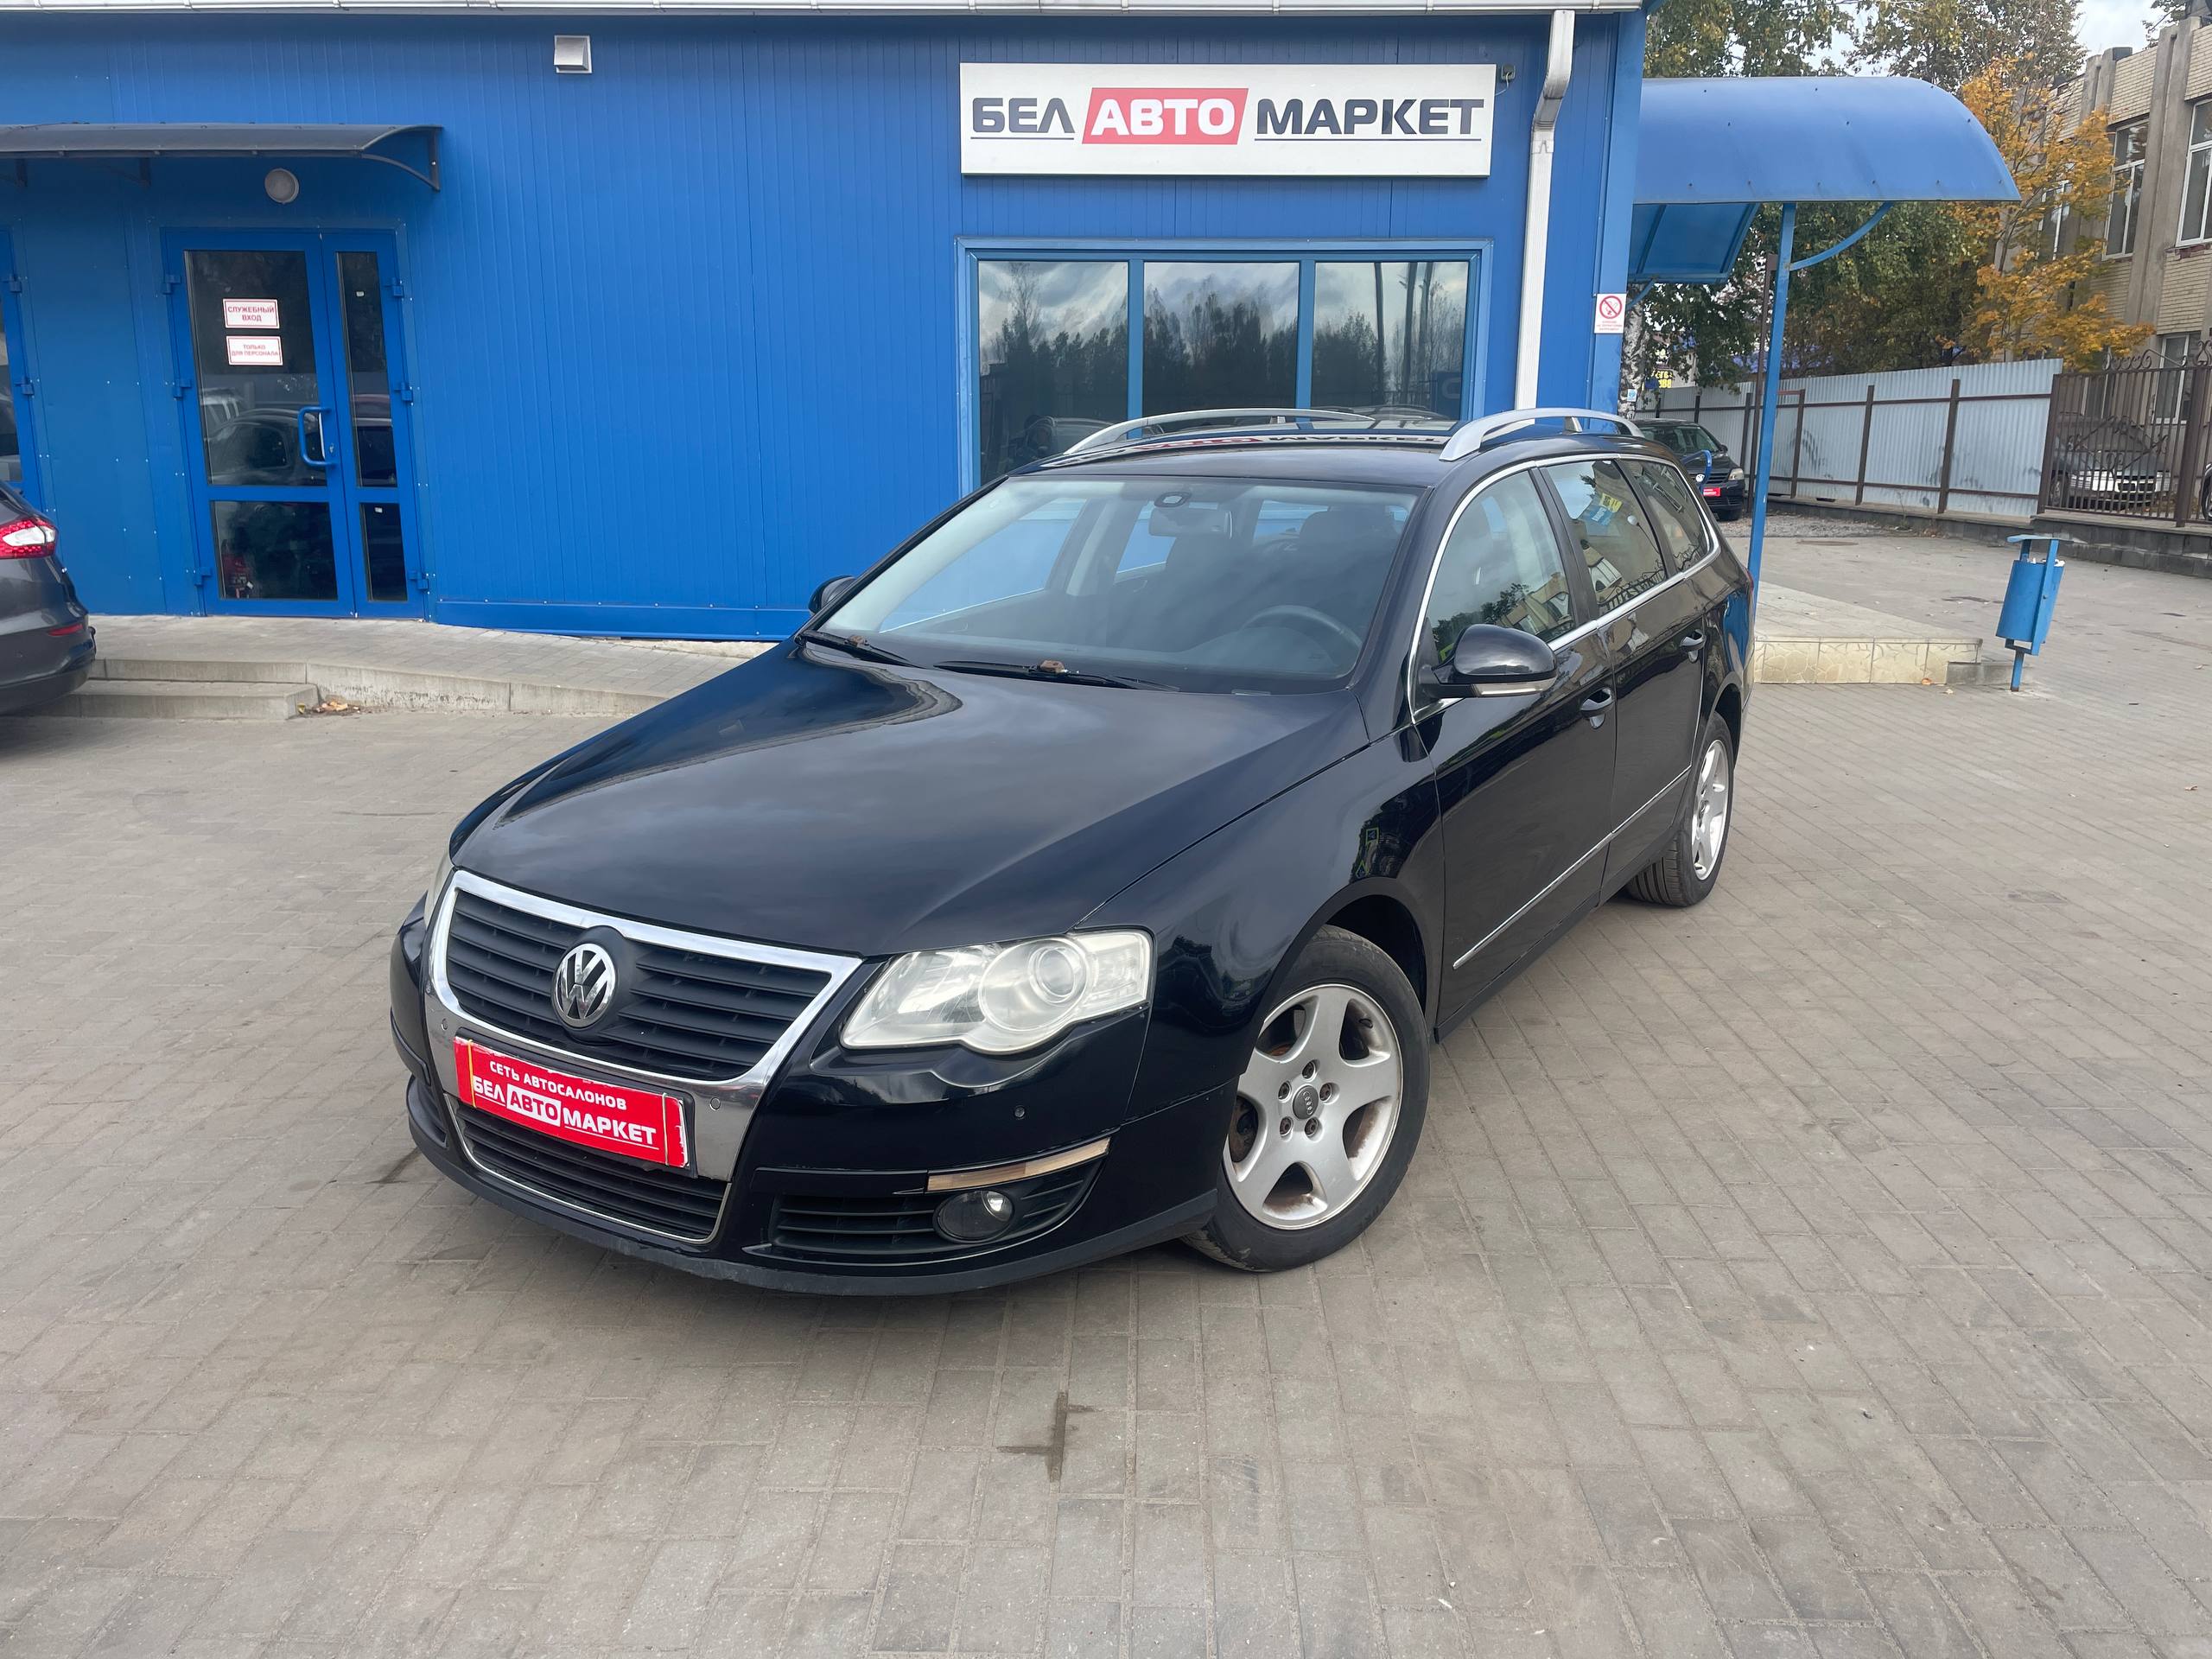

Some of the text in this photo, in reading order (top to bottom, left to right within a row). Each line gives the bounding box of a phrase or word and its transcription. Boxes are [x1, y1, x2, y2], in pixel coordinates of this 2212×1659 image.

[971, 97, 1485, 137] БЕЛ АВТО МАРКЕТ
[472, 1076, 657, 1146] БЕЛ АВТО МАРКЕТ
[489, 1060, 627, 1111] СЕТЬ АВТОСАЛОНОВ
